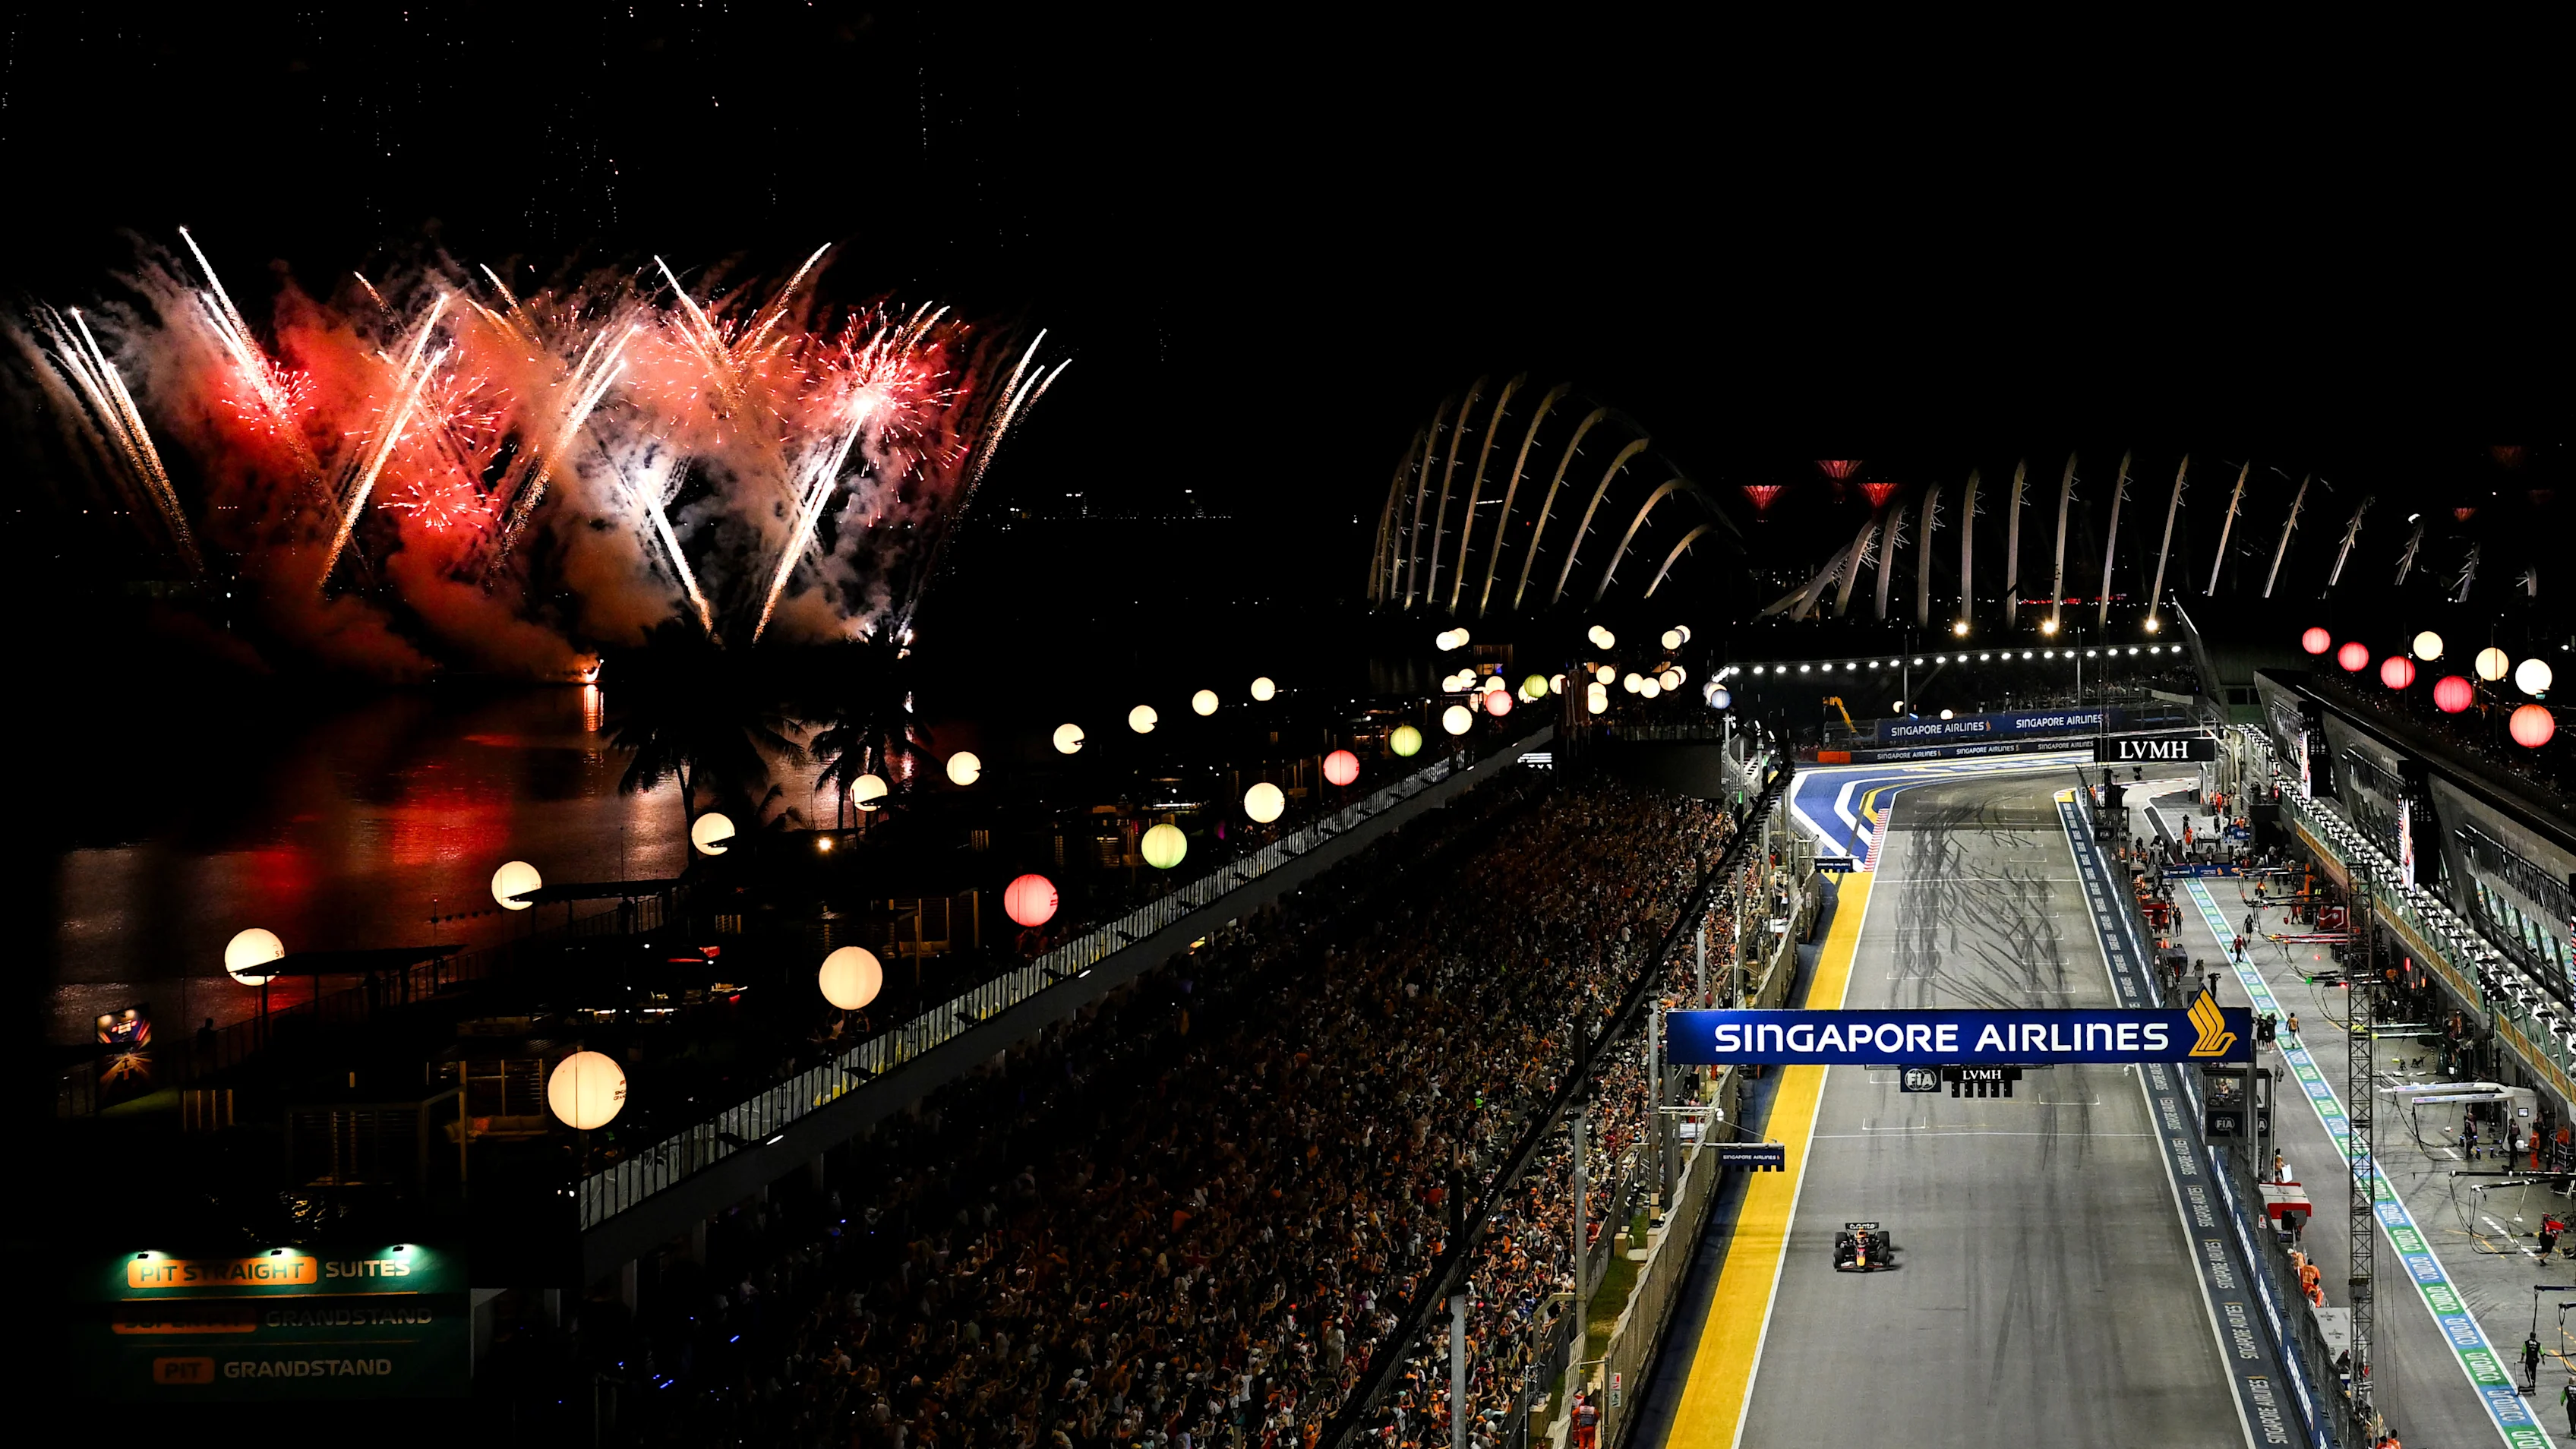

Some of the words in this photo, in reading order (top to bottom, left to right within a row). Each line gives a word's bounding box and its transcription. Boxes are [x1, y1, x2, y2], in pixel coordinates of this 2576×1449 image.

[1891, 725, 1942, 737] SINGAPORE
[1944, 721, 1984, 733] AIRLINES
[2016, 717, 2065, 728] SINGAPORE
[2066, 714, 2103, 726] AIRLINES
[1877, 751, 1911, 760] SINGAPORE
[1911, 750, 1937, 759] AIRLINES
[1956, 746, 1987, 756] SINGAPORE
[1988, 744, 2014, 753] AIRLINES
[2038, 742, 2069, 750] SINGAPORE
[2120, 741, 2189, 759] LVMH
[1716, 1024, 1959, 1053] SINGAPORE
[1975, 1023, 2169, 1052] AIRLINES
[1908, 1073, 1934, 1086] FIA
[1963, 1070, 2002, 1080] LVMH
[2217, 1119, 2233, 1129] FIA
[140, 1264, 178, 1282] PIT
[184, 1262, 305, 1282] STRAIGHT
[325, 1259, 411, 1279] SUITES
[265, 1308, 433, 1327] GRANDSTAND
[2224, 1305, 2249, 1329] AIRLINES
[2445, 1318, 2479, 1345] aramco
[2232, 1329, 2259, 1359] SINGAPORE
[164, 1362, 204, 1380] PIT
[223, 1359, 392, 1378] GRANDSTAND
[2464, 1352, 2502, 1381] aramco
[2248, 1379, 2275, 1406] AIRLINES
[2487, 1390, 2526, 1422] aramco
[2258, 1407, 2288, 1444] SINGAPORE
